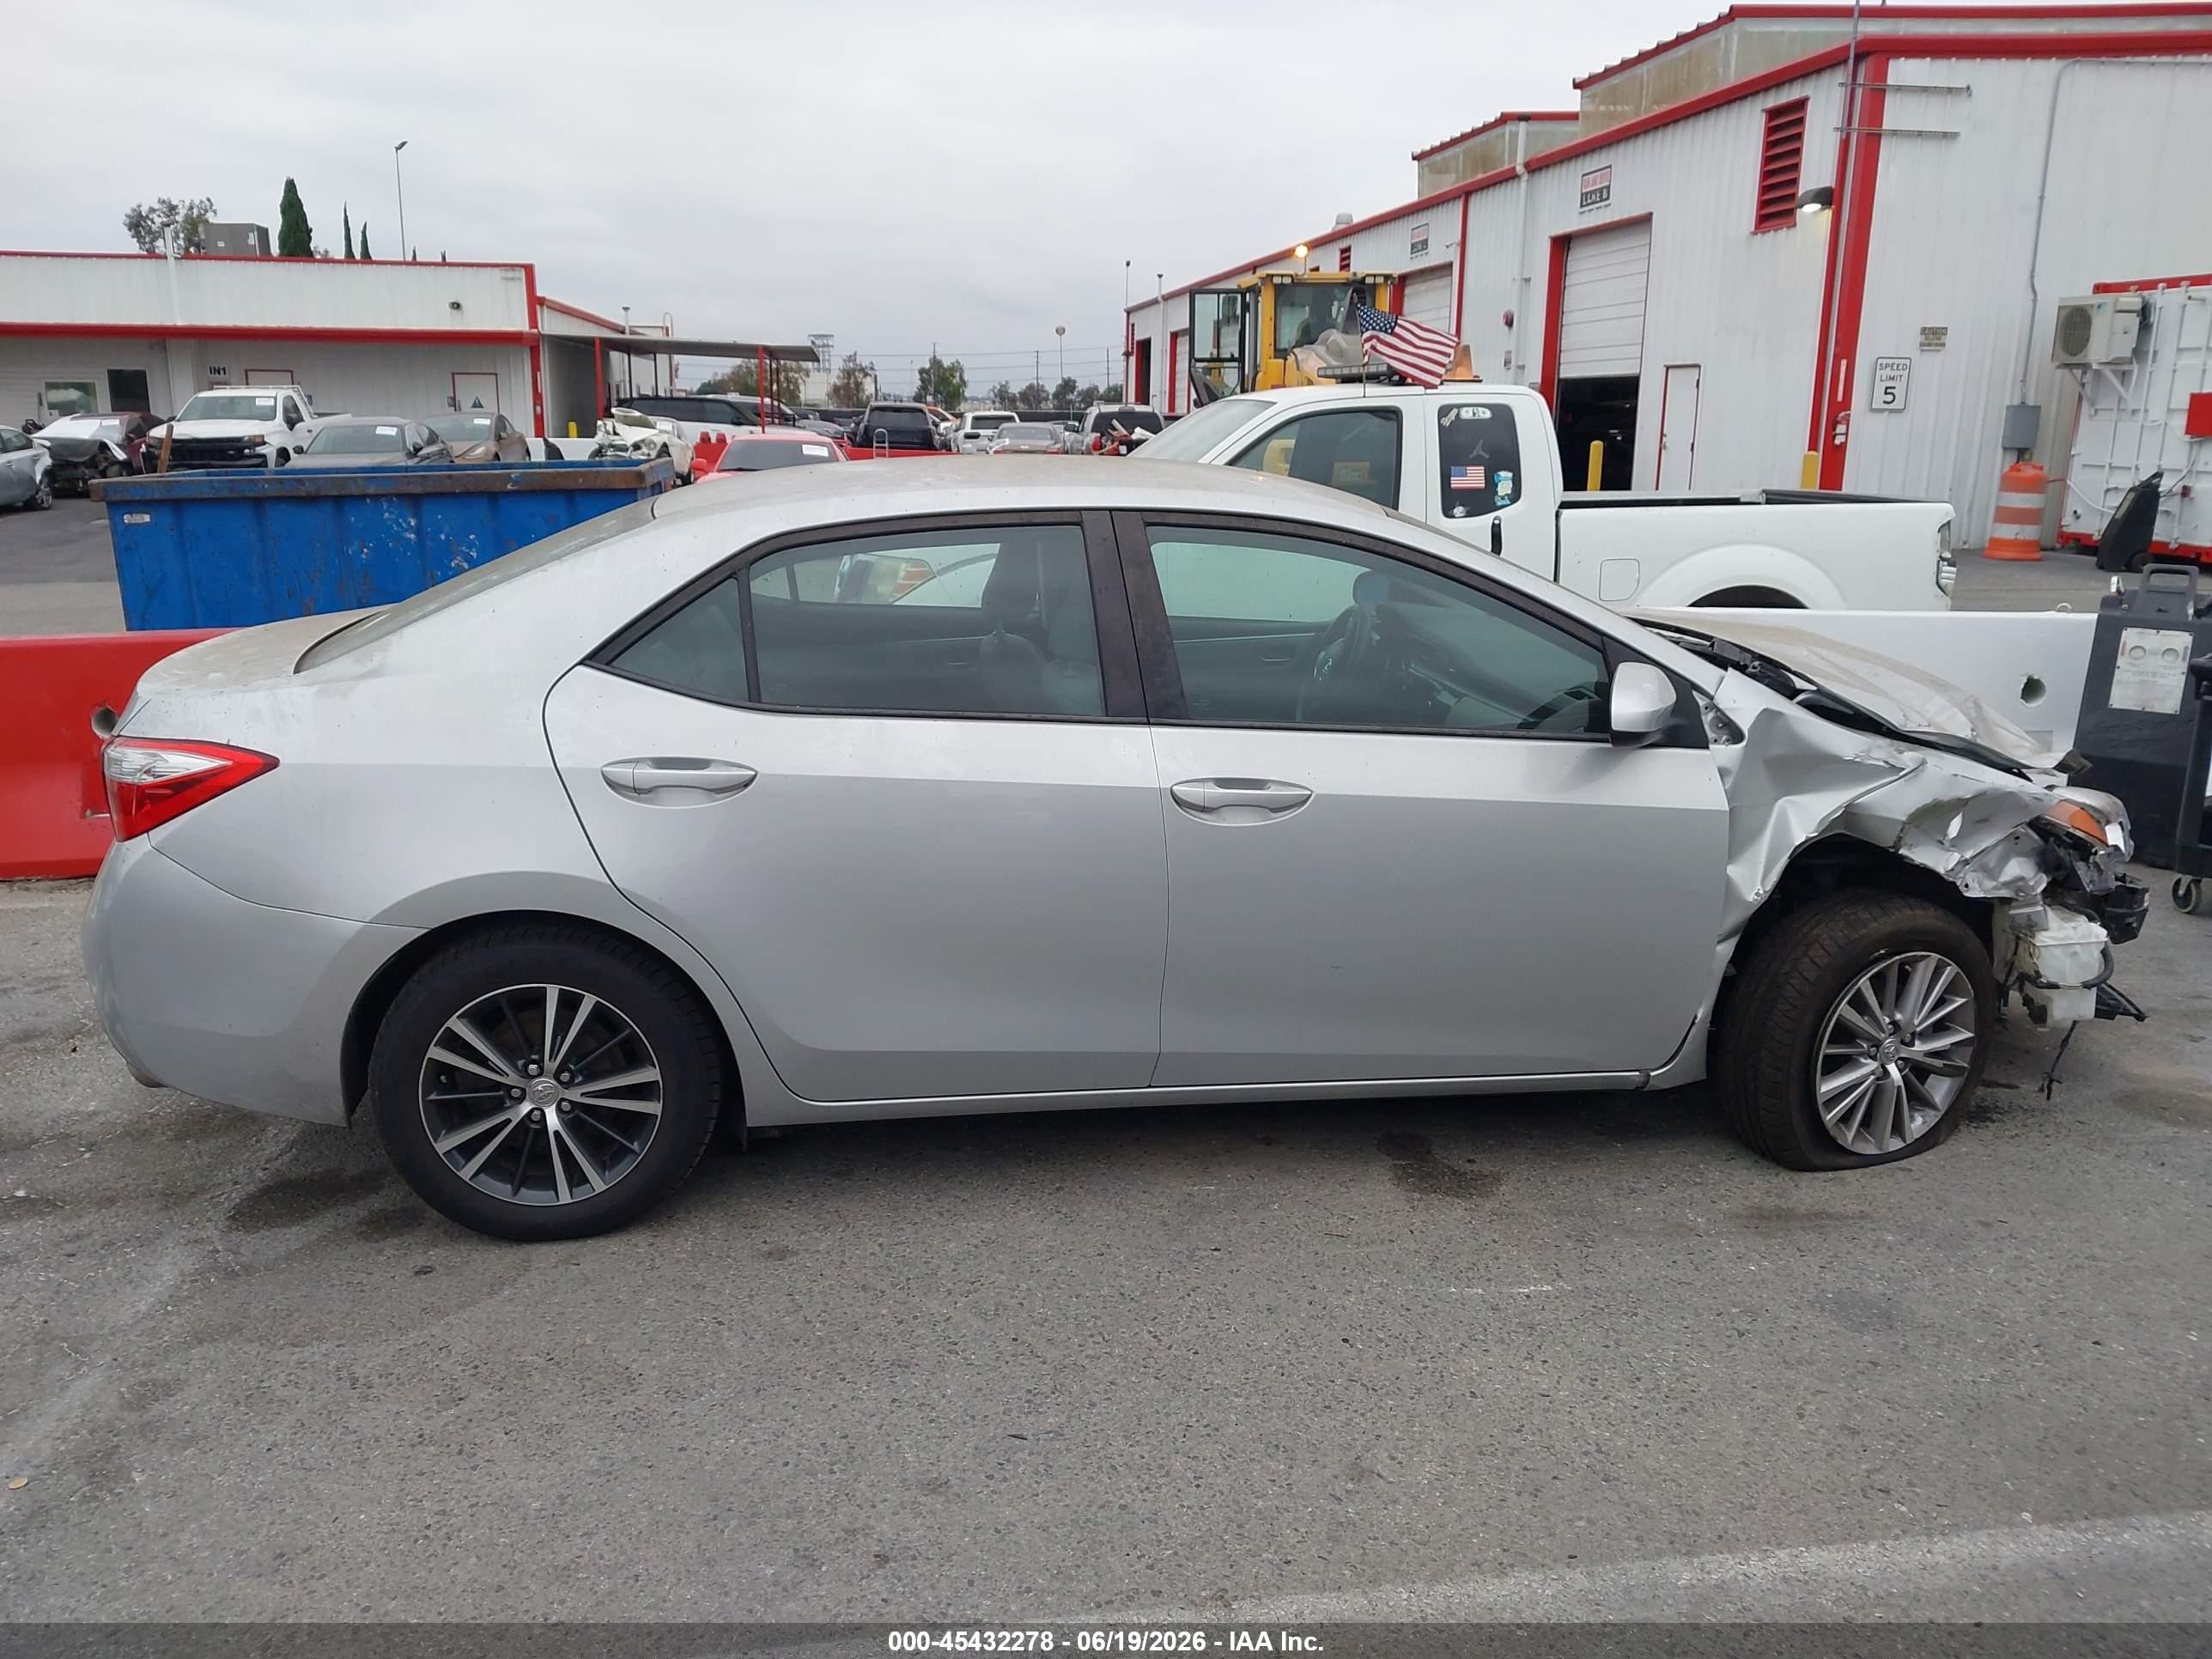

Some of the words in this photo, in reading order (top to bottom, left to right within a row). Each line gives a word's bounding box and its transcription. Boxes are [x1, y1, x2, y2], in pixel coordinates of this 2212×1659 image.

[1583, 191, 1601, 205] LANE
[209, 365, 226, 375] IN1
[1879, 362, 1907, 371] SPEED
[1880, 374, 1903, 382] LIMIT
[1882, 386, 1896, 404] 5
